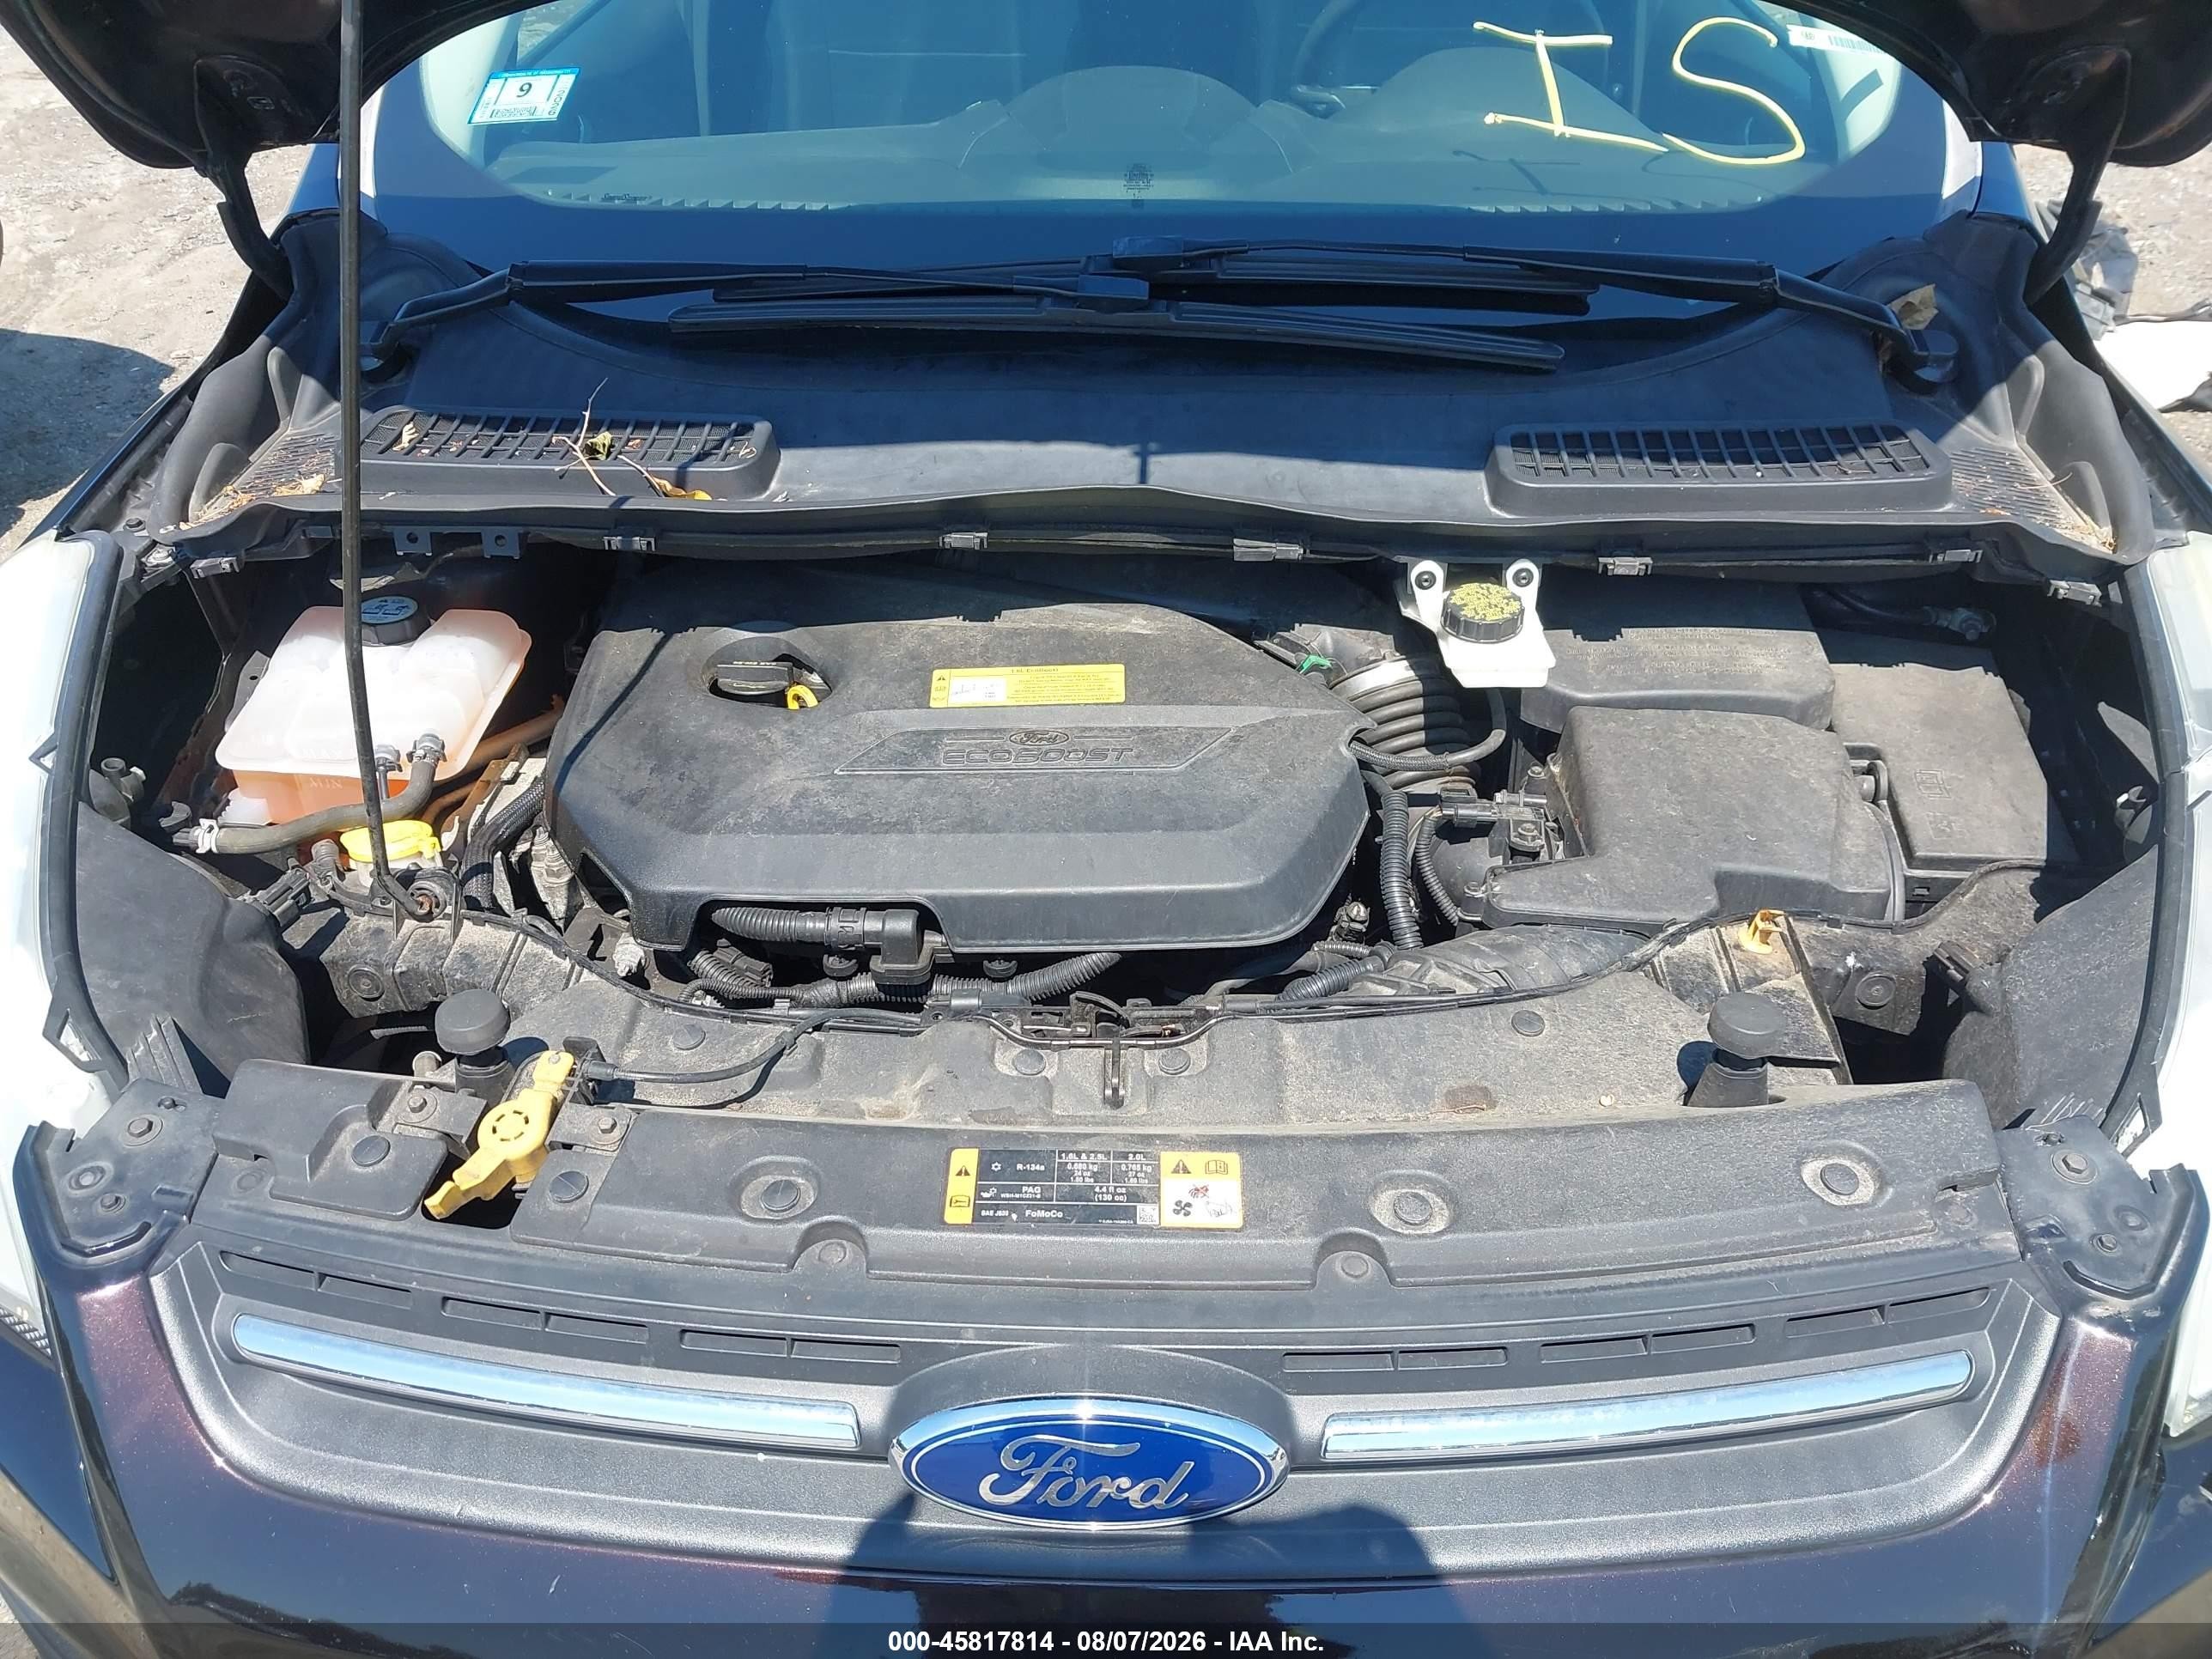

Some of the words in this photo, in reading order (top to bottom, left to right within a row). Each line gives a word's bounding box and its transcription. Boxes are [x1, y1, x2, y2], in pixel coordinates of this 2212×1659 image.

[515, 82, 532, 98] 9
[1019, 731, 1059, 744] Ford
[943, 747, 1133, 764] ECOBOOST
[1016, 1163, 1045, 1171] R-134a
[1088, 1163, 1098, 1172] kg
[1142, 1164, 1152, 1173] kg
[1094, 1194, 1113, 1202] (130
[1024, 1209, 1064, 1218] FoMoCo
[977, 1433, 1195, 1510] Ford
